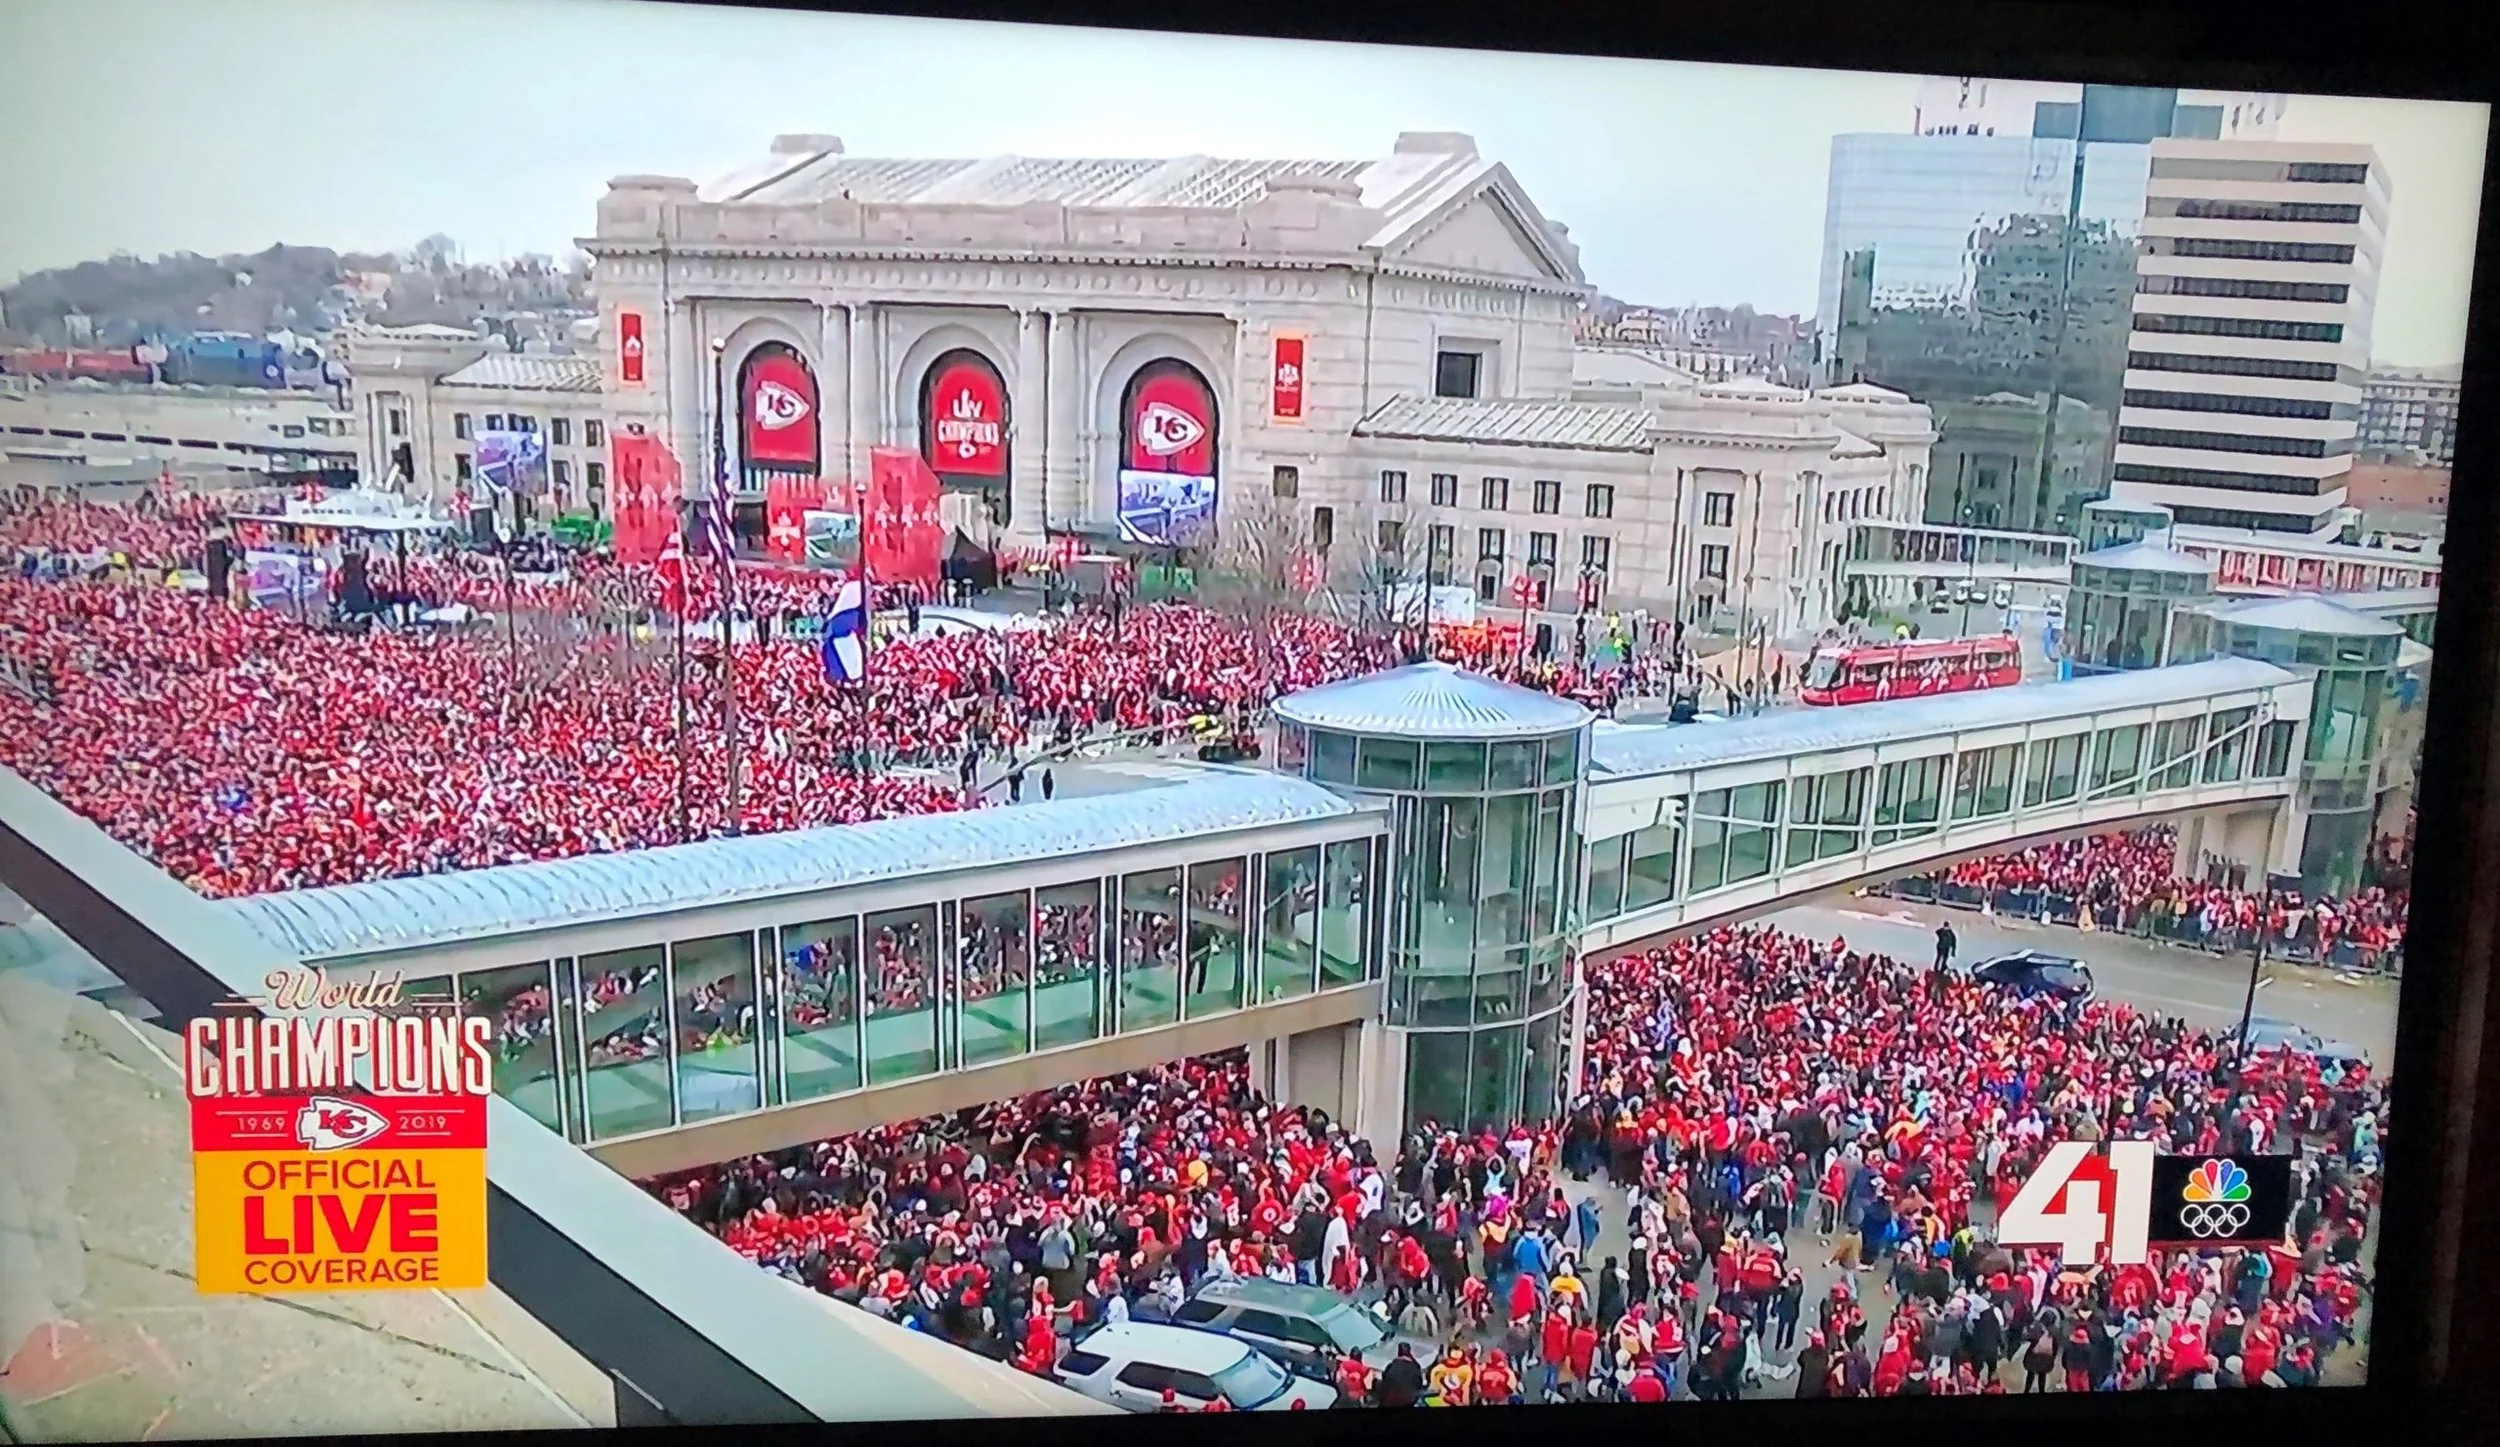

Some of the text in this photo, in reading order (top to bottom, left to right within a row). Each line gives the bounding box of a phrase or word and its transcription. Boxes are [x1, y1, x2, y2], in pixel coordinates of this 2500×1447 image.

[264, 968, 405, 1010] World
[185, 1016, 492, 1097] CHAMPIONS
[238, 1116, 286, 1132] 1969
[400, 1115, 447, 1131] 2019
[243, 1159, 436, 1191] OFFICIAL
[1998, 1141, 2154, 1265] 41
[244, 1193, 439, 1255] LIVE
[244, 1258, 439, 1285] COVERAGE
